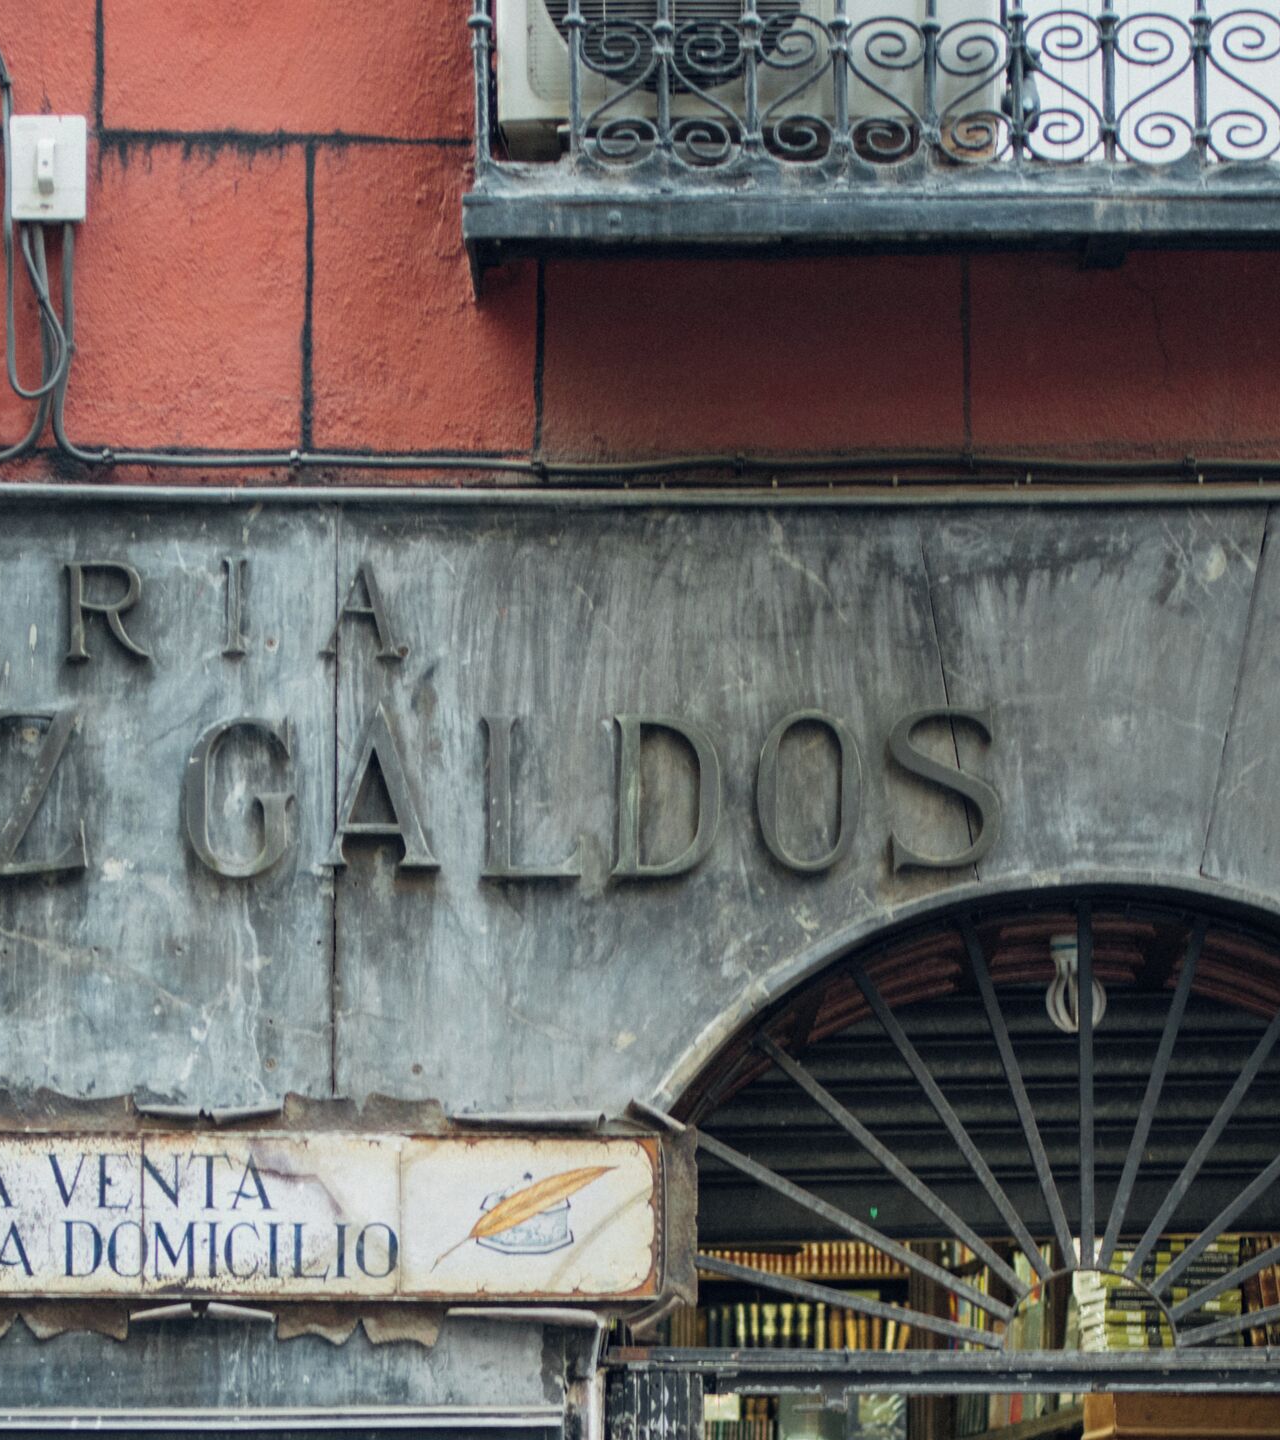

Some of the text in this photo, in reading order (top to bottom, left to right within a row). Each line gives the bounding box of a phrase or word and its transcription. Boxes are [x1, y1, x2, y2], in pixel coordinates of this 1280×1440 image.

[182, 703, 1003, 880] GALDOS
[48, 1151, 273, 1212] VENTA
[63, 1219, 400, 1283] DOMICILIO
